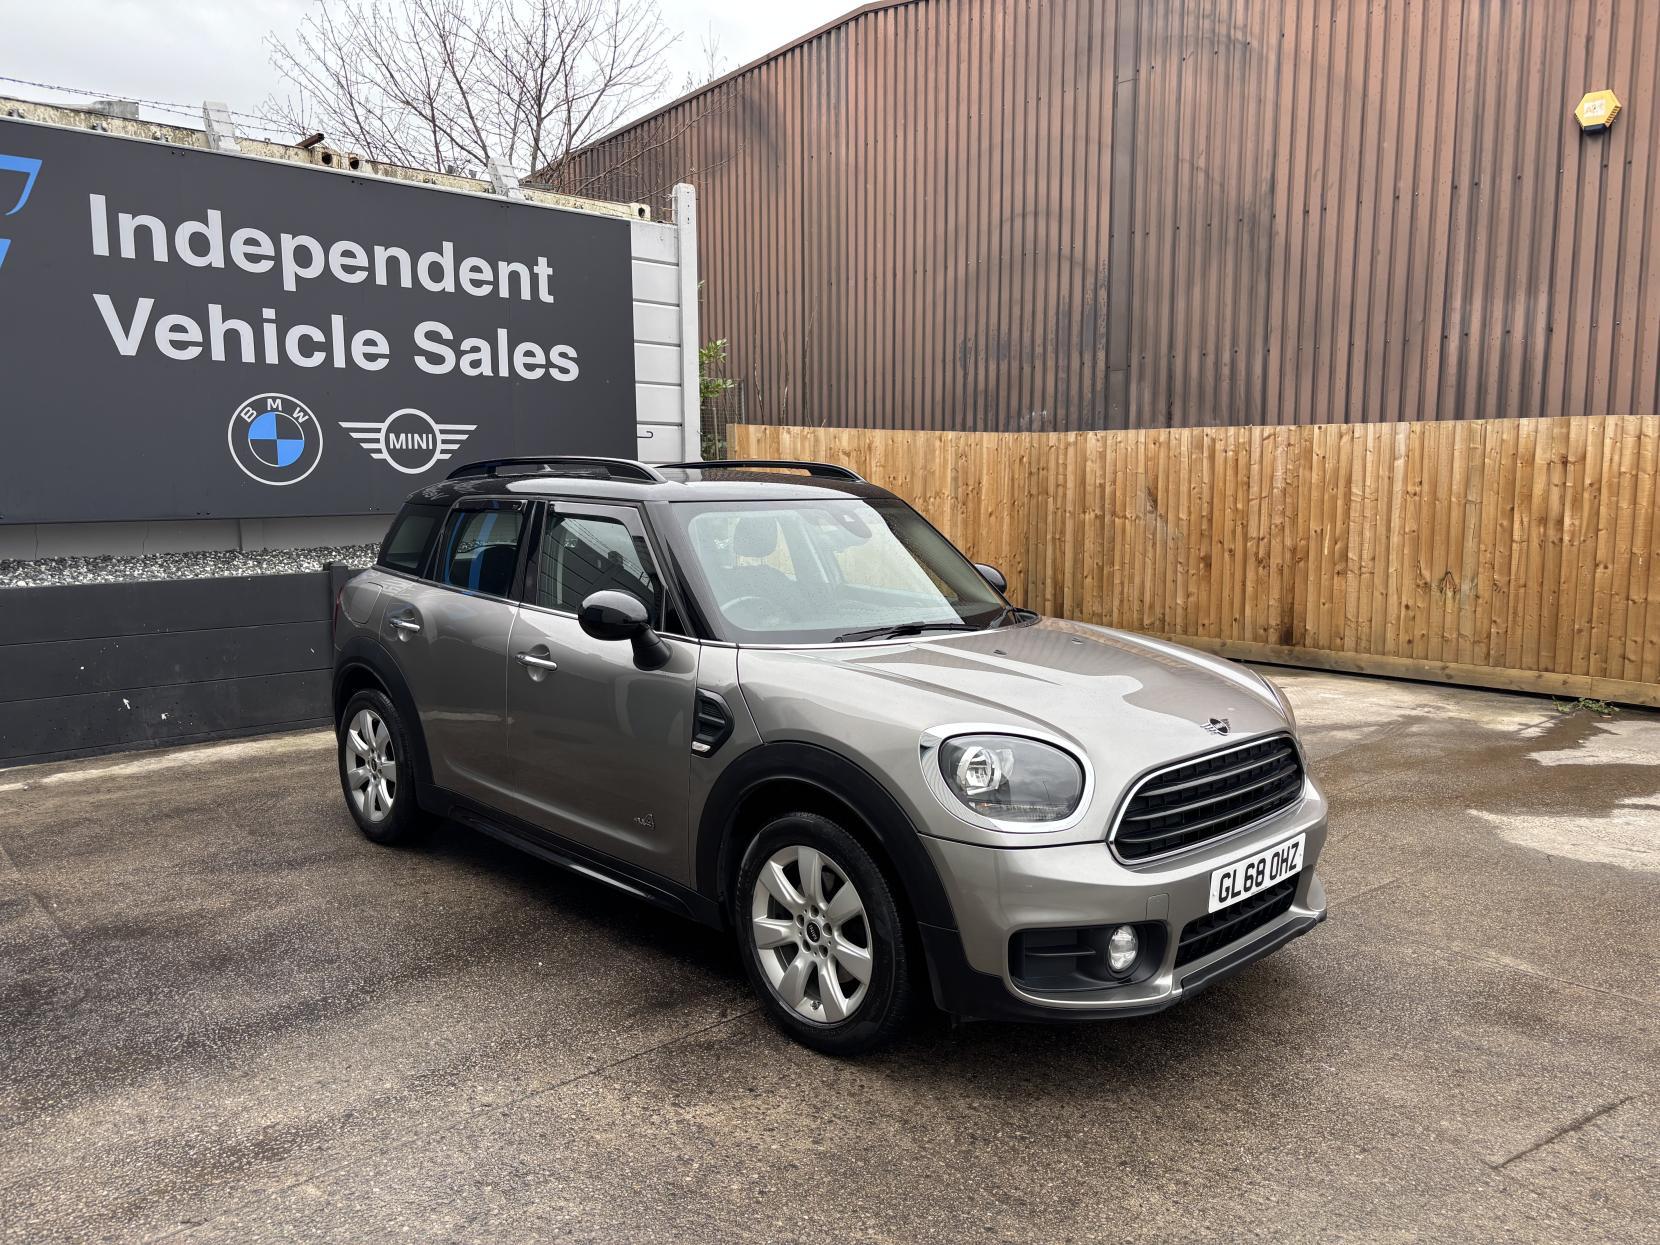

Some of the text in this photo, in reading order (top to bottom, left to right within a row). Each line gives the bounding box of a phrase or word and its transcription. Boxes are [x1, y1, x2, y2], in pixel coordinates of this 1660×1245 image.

[90, 194, 554, 303] Independent
[93, 294, 579, 381] Vehicle Sales
[240, 399, 309, 423] BMW
[389, 433, 433, 449] MINI
[1218, 841, 1300, 903] GL68 OHZ
